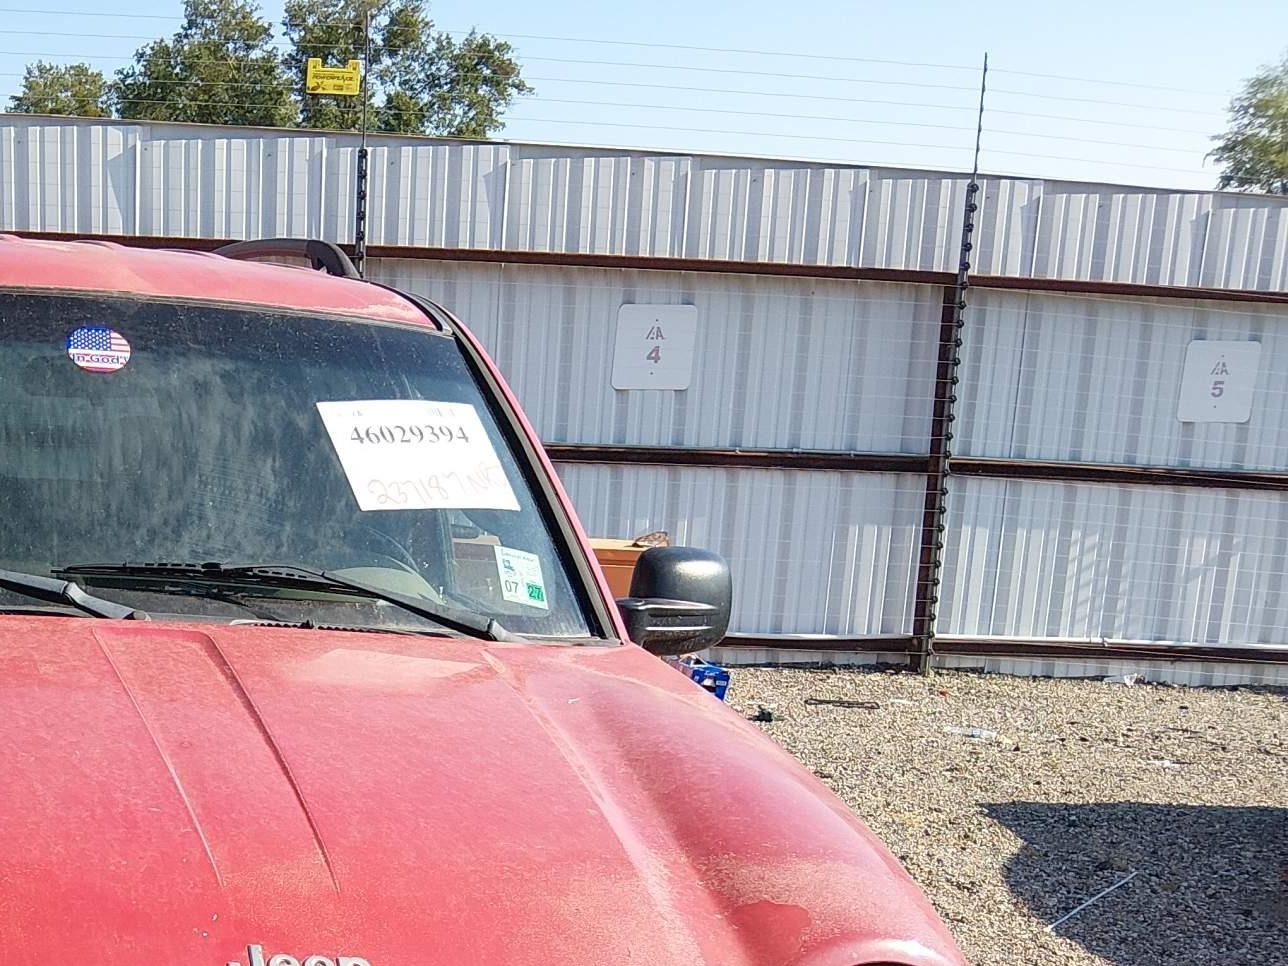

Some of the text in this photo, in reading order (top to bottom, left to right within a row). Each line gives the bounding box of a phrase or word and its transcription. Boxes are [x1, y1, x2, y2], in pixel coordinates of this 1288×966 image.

[90, 353, 119, 365] God
[646, 345, 661, 364] 4
[1211, 380, 1225, 398] 5
[350, 425, 470, 445] 46029394
[504, 579, 519, 593] 07
